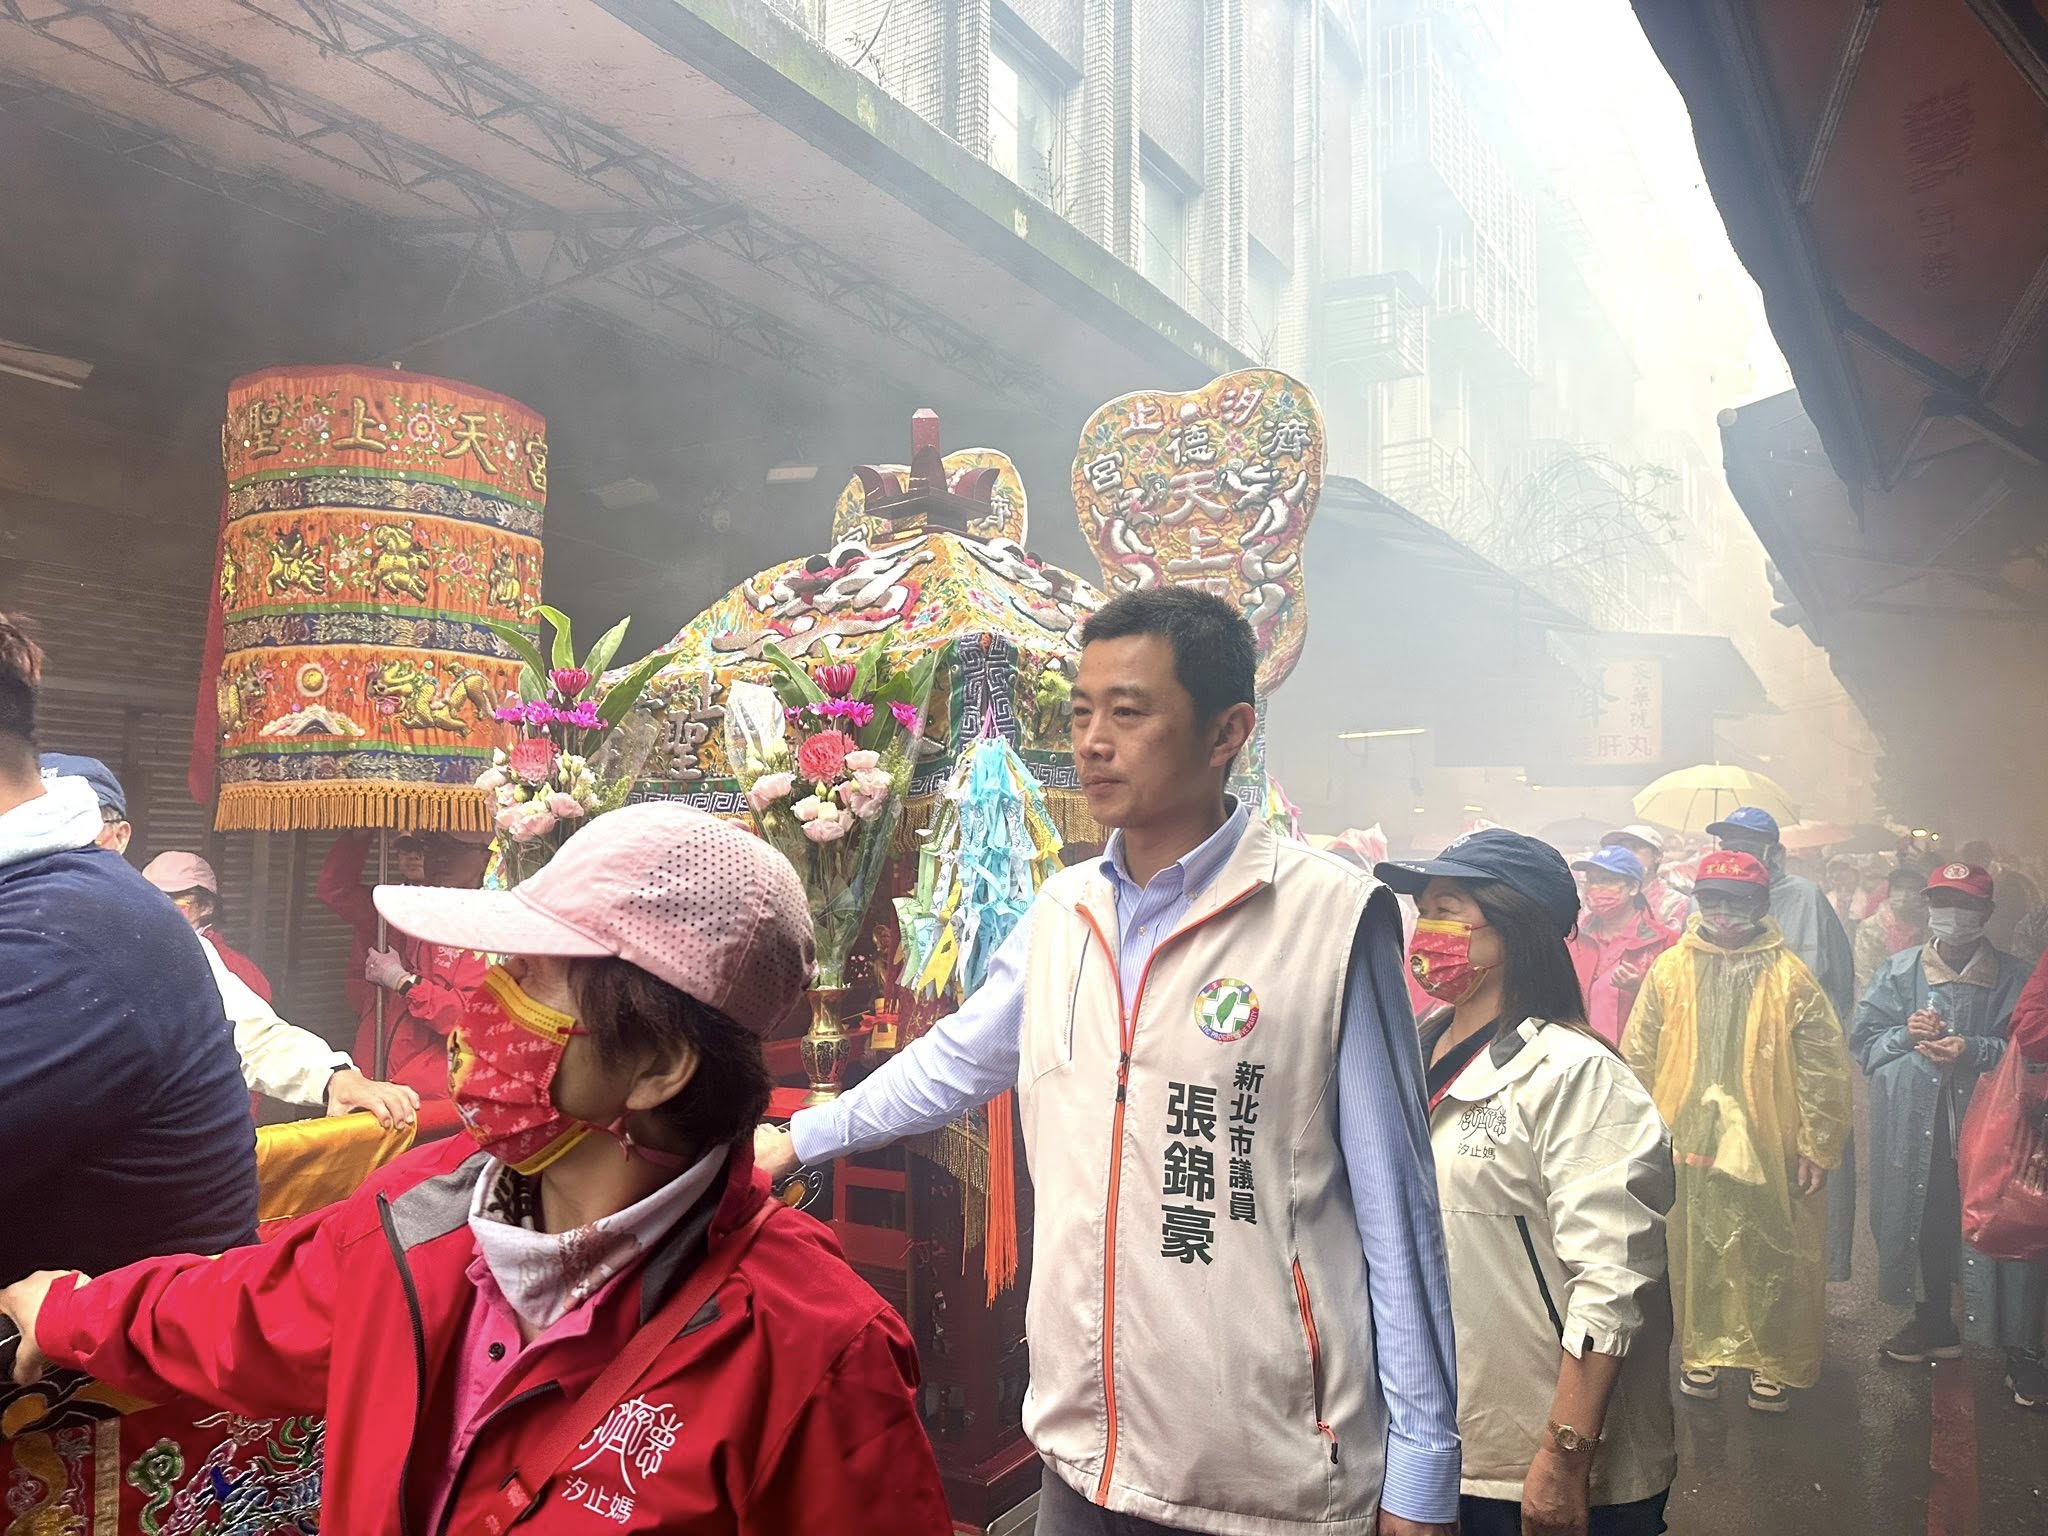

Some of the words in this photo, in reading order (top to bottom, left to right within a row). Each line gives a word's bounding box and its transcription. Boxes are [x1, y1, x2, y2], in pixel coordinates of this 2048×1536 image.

[1083, 419, 1312, 494] 濟德宮
[1160, 1081, 1218, 1266] 張錦豪
[1229, 1060, 1266, 1226] 新北市議員
[1457, 1142, 1496, 1161] 汐止媽
[561, 1475, 635, 1525] 汐止媽
